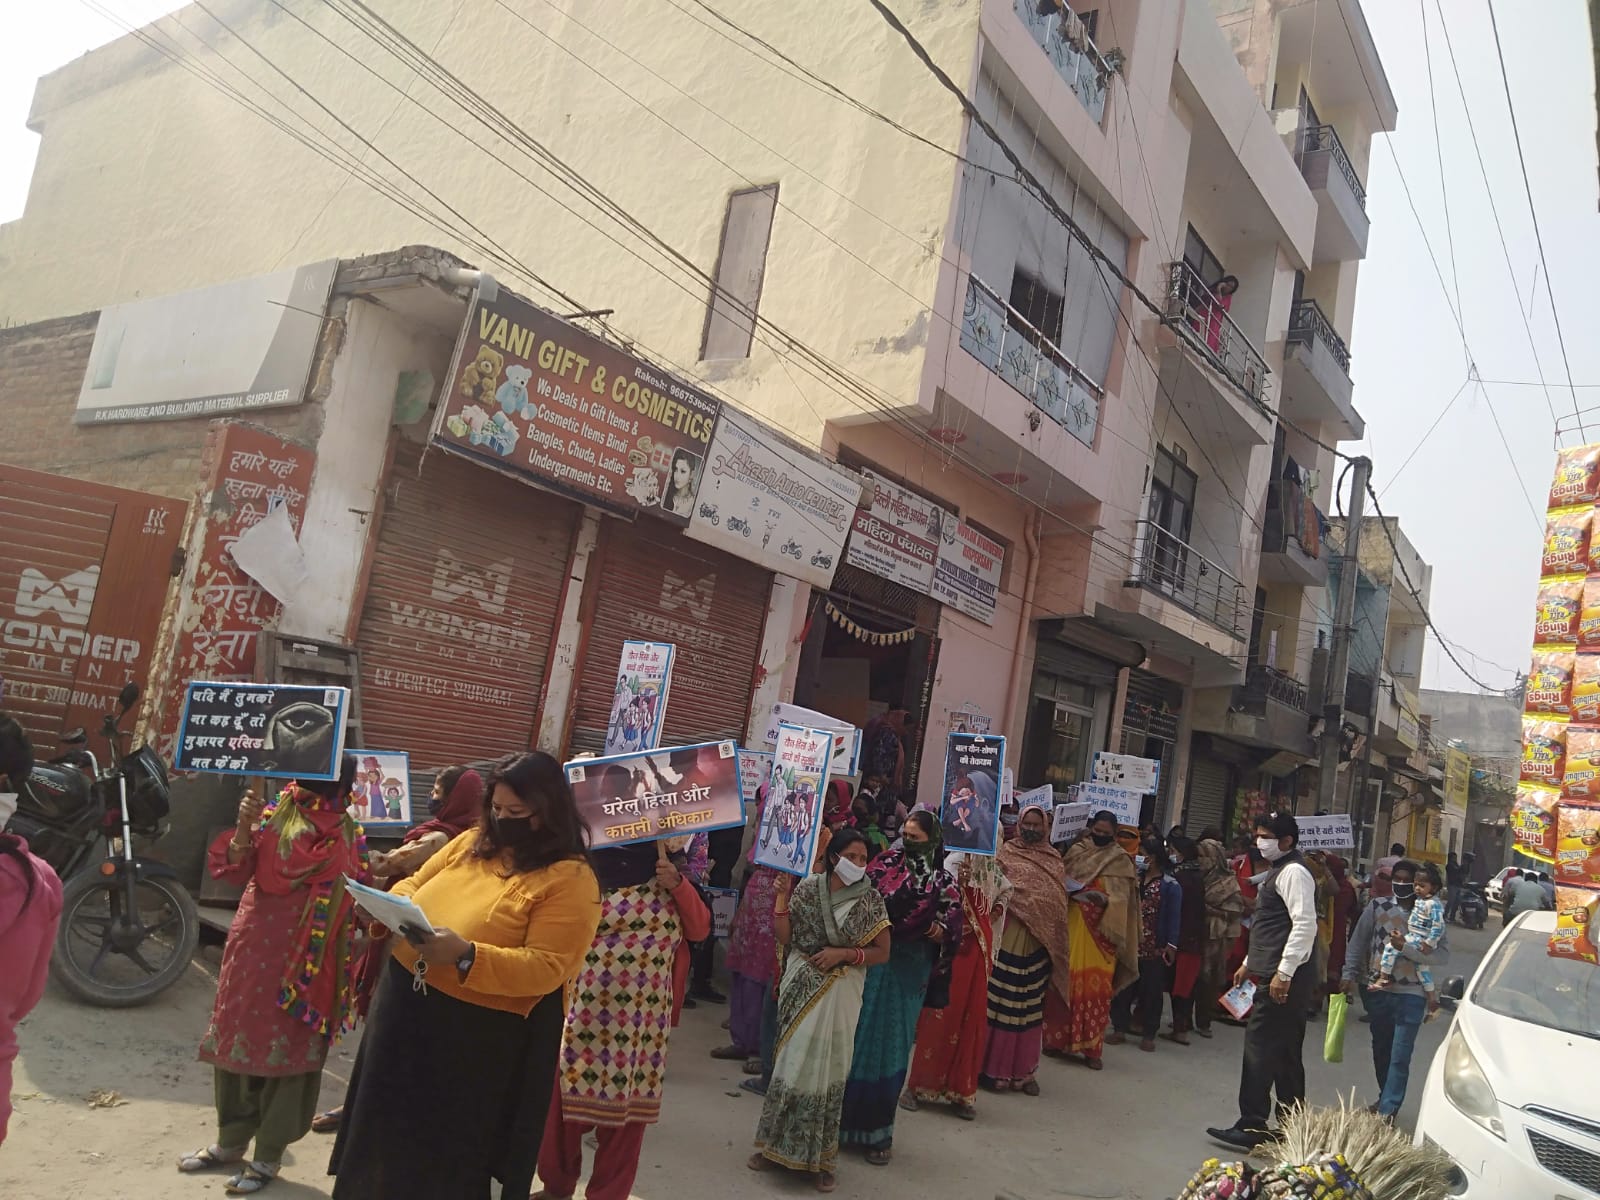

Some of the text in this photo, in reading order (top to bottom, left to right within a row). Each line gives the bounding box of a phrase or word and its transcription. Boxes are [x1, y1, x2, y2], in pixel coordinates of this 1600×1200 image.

[480, 308, 535, 361] VANI
[538, 340, 589, 384] GIFT
[591, 366, 606, 395] &
[108, 407, 149, 418] HARDWARE
[150, 405, 166, 417] AND
[167, 401, 204, 415] BUILDING
[204, 397, 244, 410] MATERIAL
[245, 389, 289, 406] SUPPLIER
[536, 377, 639, 436] We Deals In Gift Items &
[538, 404, 629, 454] Cosmetic Items Bindi
[230, 450, 300, 480] हमारे यहाँ
[527, 424, 626, 475] Bangles, Chuda, Ladies
[529, 449, 613, 494] Undergarments Etc.
[727, 443, 845, 516] Akash Auto Center
[225, 478, 266, 500] खुला
[1552, 483, 1585, 498] Rings
[857, 517, 895, 544] महिला
[898, 534, 935, 561] पंचायत
[1544, 551, 1576, 567] Rings
[0, 618, 141, 664] ONDER
[1536, 622, 1569, 634] Rings
[1527, 692, 1561, 704] Rings
[250, 714, 267, 728] तो
[1521, 761, 1554, 775] Rings
[602, 783, 712, 817] घरेलू हिंसा और
[605, 809, 715, 840] कानूनी अधिकार
